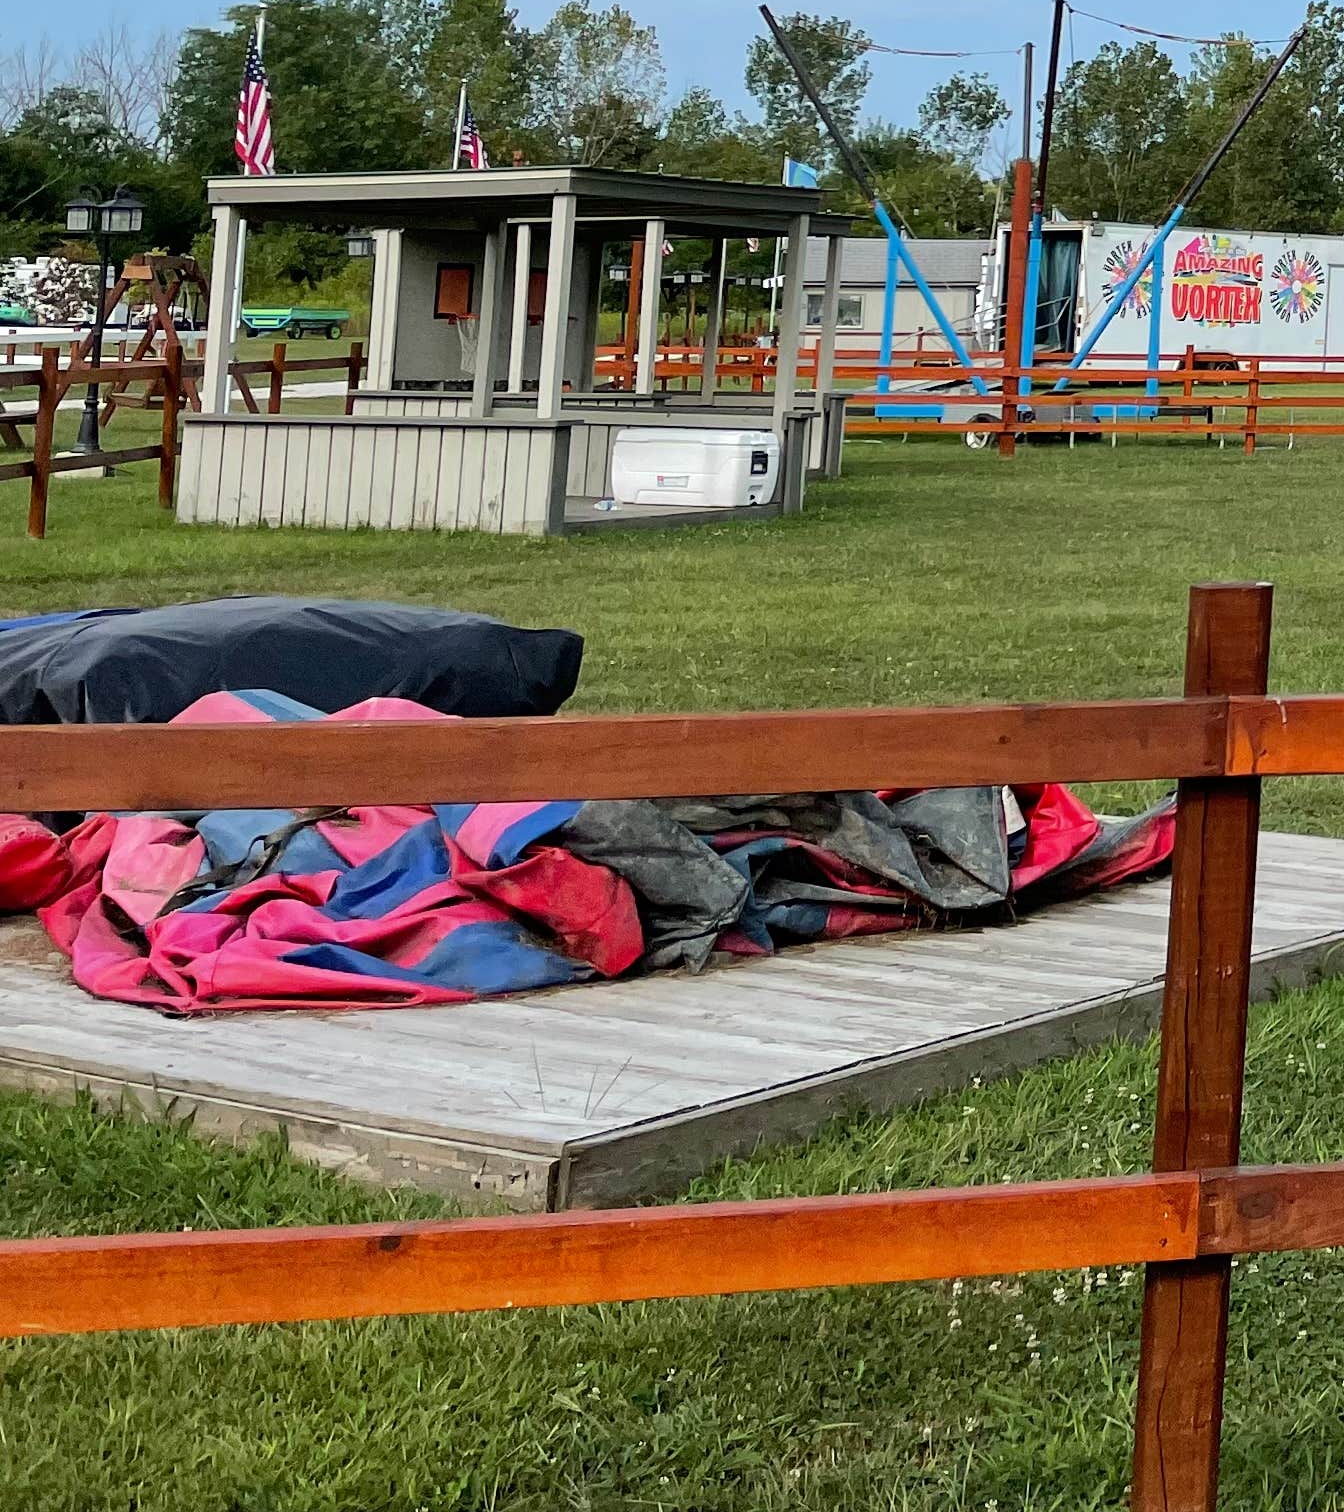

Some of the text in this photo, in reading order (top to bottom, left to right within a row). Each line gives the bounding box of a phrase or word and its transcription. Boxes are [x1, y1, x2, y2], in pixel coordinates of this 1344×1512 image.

[1103, 240, 1133, 273] VORTEX
[1173, 249, 1264, 280] AMAZING
[1271, 249, 1297, 279] VORTEX
[1304, 251, 1325, 286] VORTEX
[1172, 283, 1263, 324] VORTEX
[1299, 292, 1325, 324] VORTEX
